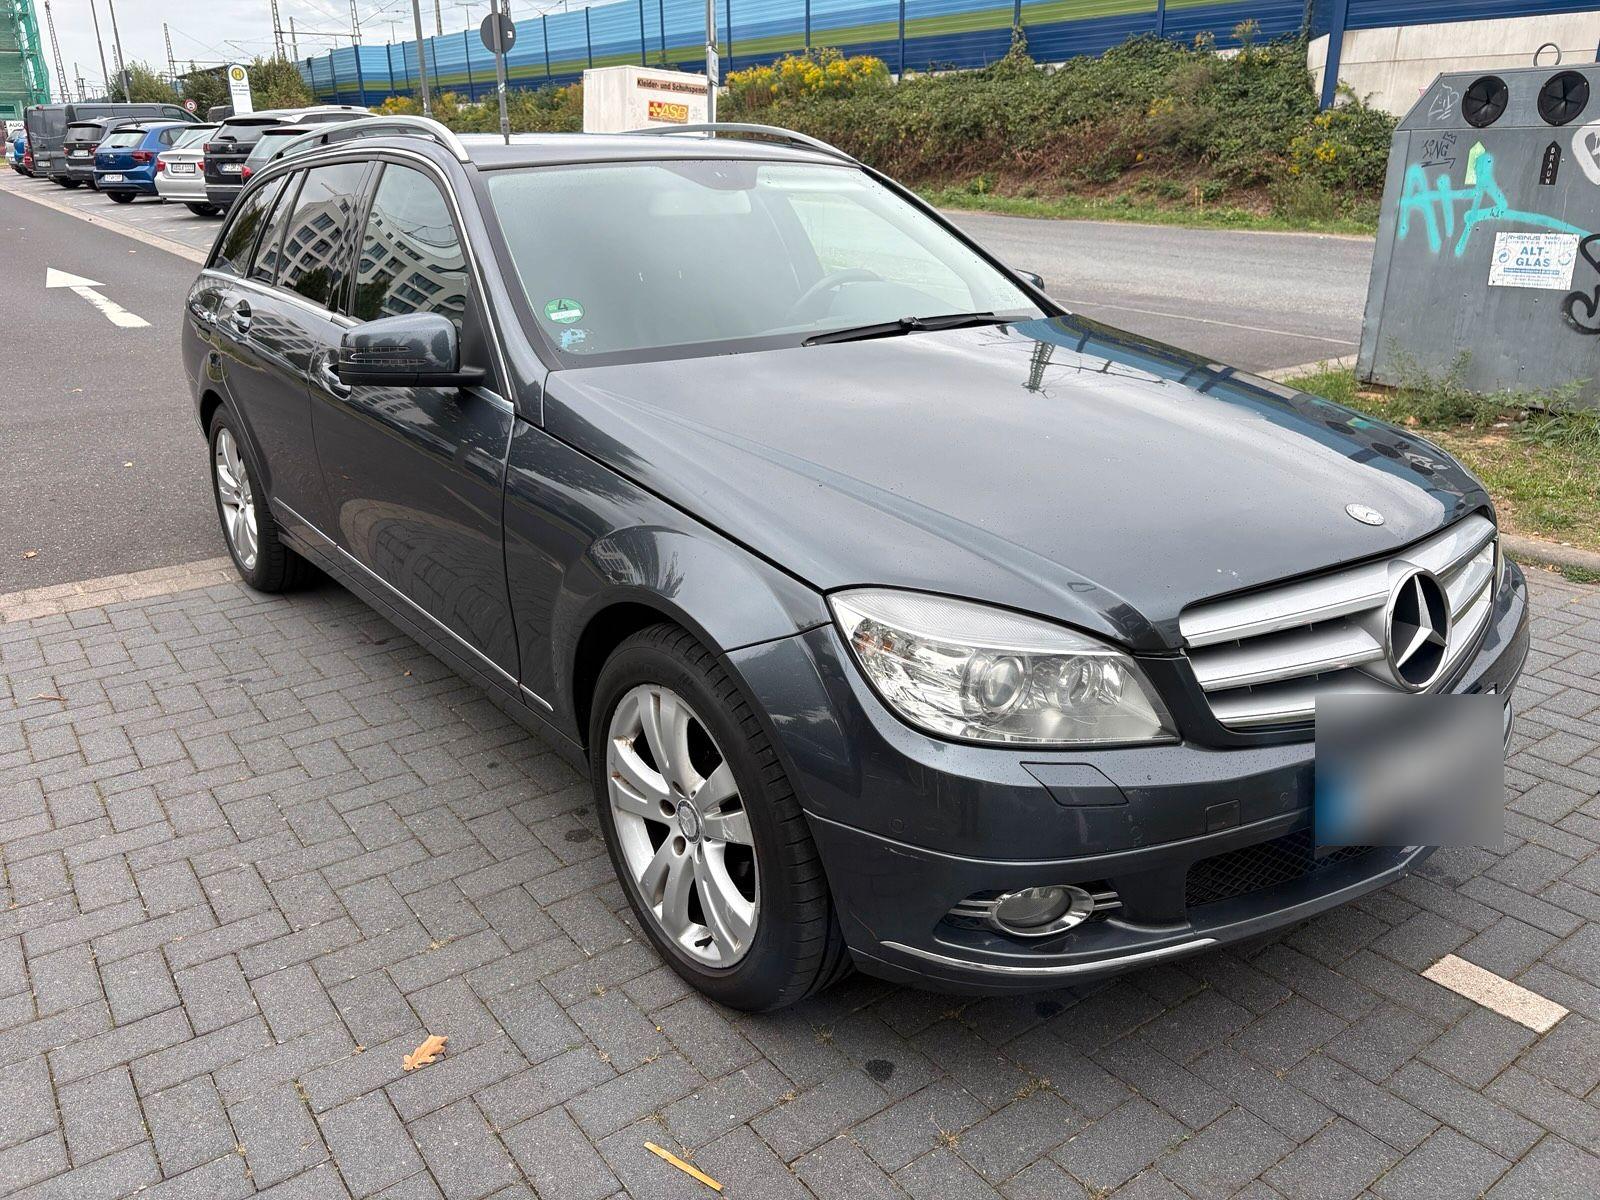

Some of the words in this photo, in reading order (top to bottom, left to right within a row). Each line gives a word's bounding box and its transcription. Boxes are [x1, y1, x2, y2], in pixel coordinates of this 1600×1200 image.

[637, 79, 659, 88] Kleider-
[660, 82, 671, 91] und
[659, 103, 689, 120] ASB
[1545, 147, 1556, 185] BRAUN
[1520, 246, 1550, 256] ALT-
[1515, 257, 1551, 267] GLAS
[558, 300, 568, 311] 4
